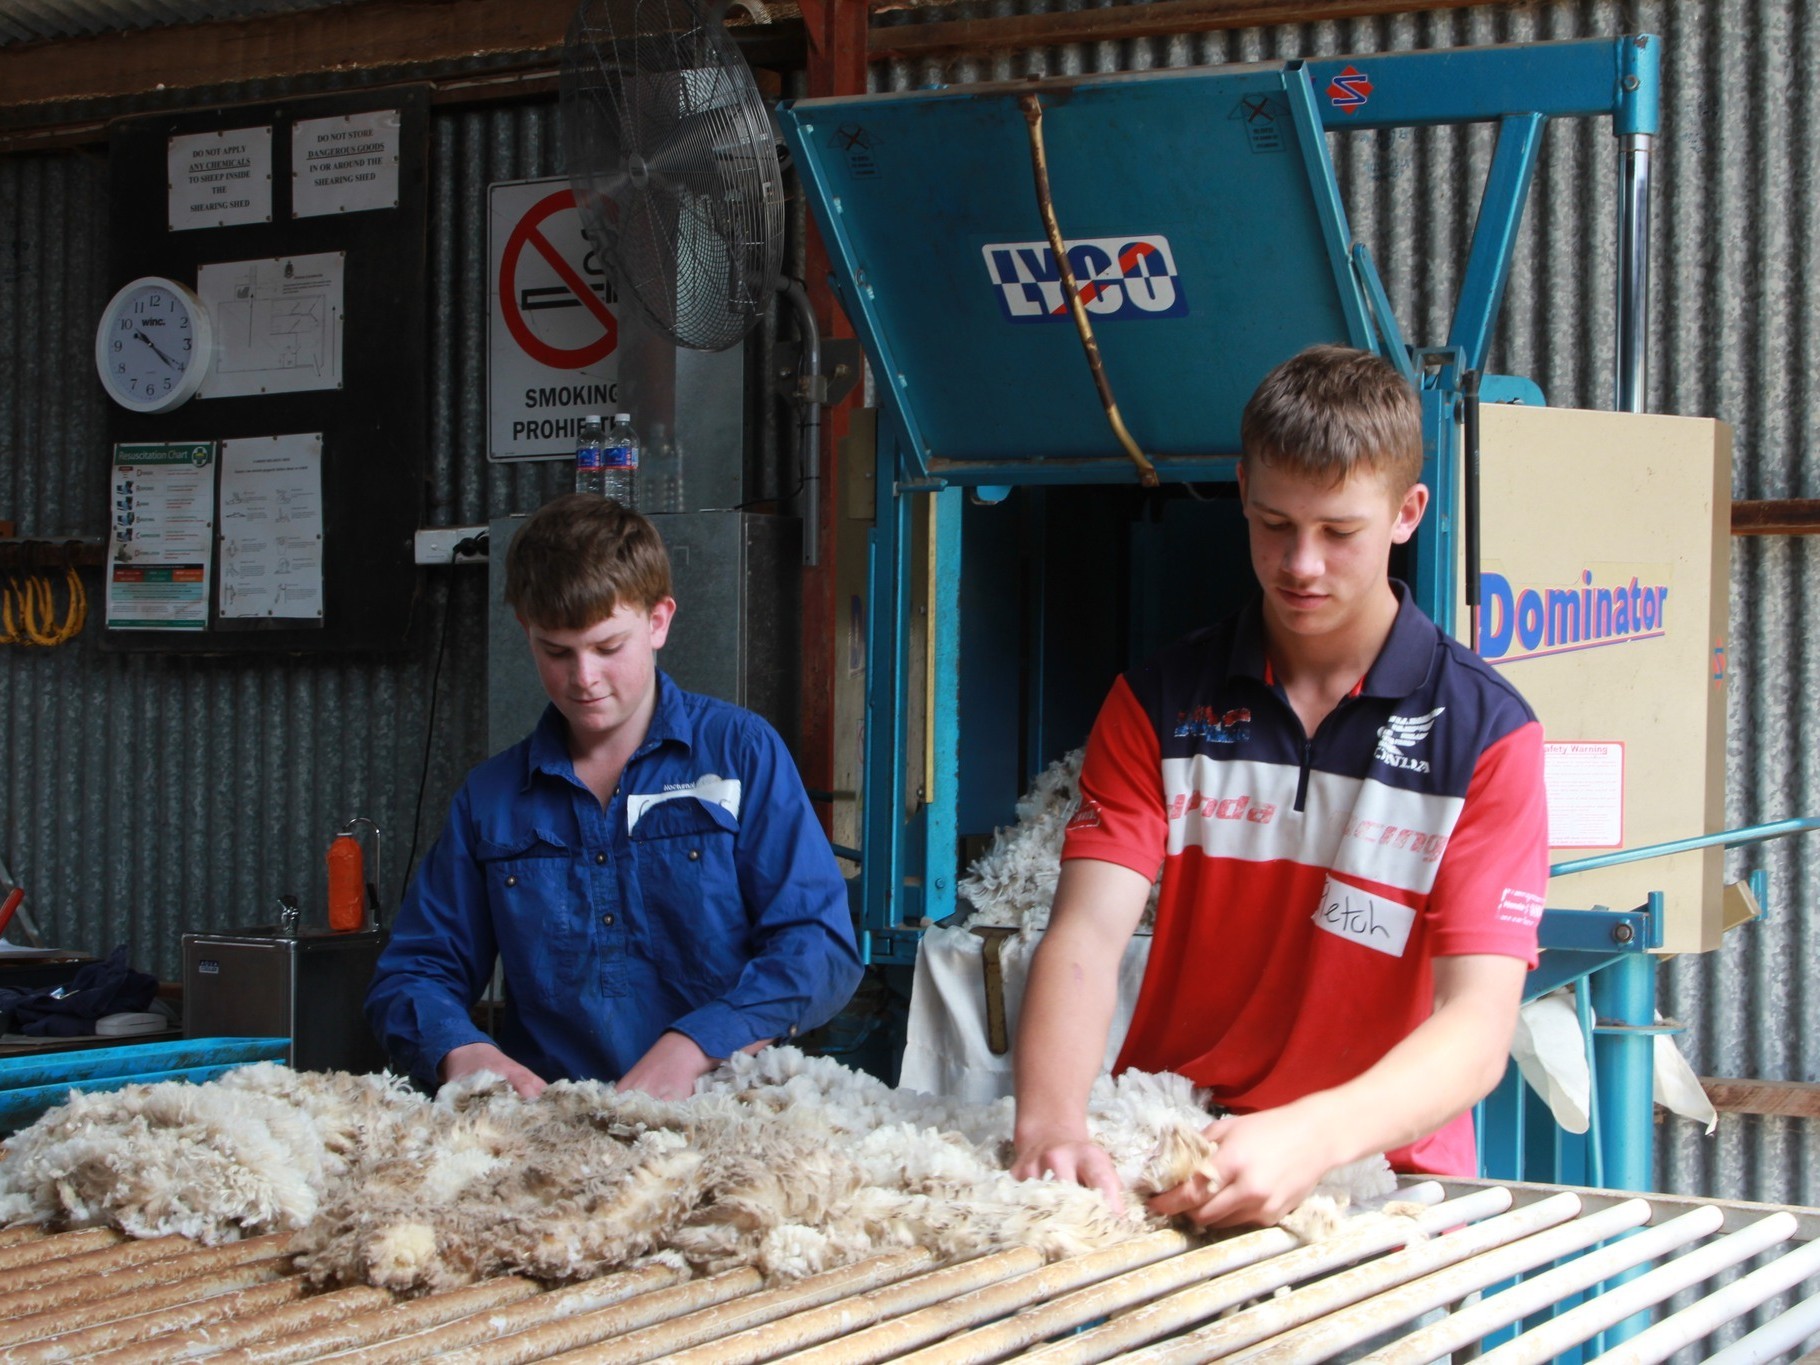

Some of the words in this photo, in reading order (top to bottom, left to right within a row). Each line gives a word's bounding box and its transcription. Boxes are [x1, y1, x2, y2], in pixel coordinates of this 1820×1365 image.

[317, 134, 329, 143] DO
[330, 132, 347, 141] NOT
[348, 129, 374, 139] STORE
[192, 149, 204, 158] DO
[205, 148, 221, 156] NOT
[222, 145, 247, 155] APPLY
[307, 146, 356, 158] DANGEROUS
[357, 142, 385, 153] GOODS
[189, 162, 205, 171] ANY
[205, 157, 251, 169] CHEMICALS
[309, 165, 318, 173] IN
[319, 163, 332, 171] OR
[333, 160, 365, 170] AROUND
[367, 157, 383, 166] THE
[189, 176, 199, 184] TO
[200, 174, 225, 183] SHEEP
[226, 171, 251, 180] INSIDE
[314, 175, 353, 187] SHEARING
[355, 172, 376, 181] SHED
[212, 186, 227, 194] THE
[190, 201, 228, 212] SHEARING
[229, 199, 250, 208] SHED
[991, 241, 1176, 316] LYCO
[149, 295, 161, 307] 12
[170, 301, 175, 312] 1
[134, 302, 144, 314] 11
[120, 318, 133, 330] 10
[179, 316, 189, 329] 2
[113, 340, 123, 352] 9
[183, 338, 192, 351] 3
[118, 362, 126, 374] 8
[130, 378, 137, 390] 7
[146, 384, 155, 396] 6
[163, 378, 171, 390] 5
[525, 384, 617, 408] SMOKING
[513, 415, 616, 441] PROHIBT
[118, 450, 167, 461] Resuscitation
[168, 449, 188, 460] Chart
[1475, 569, 1668, 658] Dominator
[1544, 745, 1568, 755] afety
[1570, 745, 1608, 755] Warning
